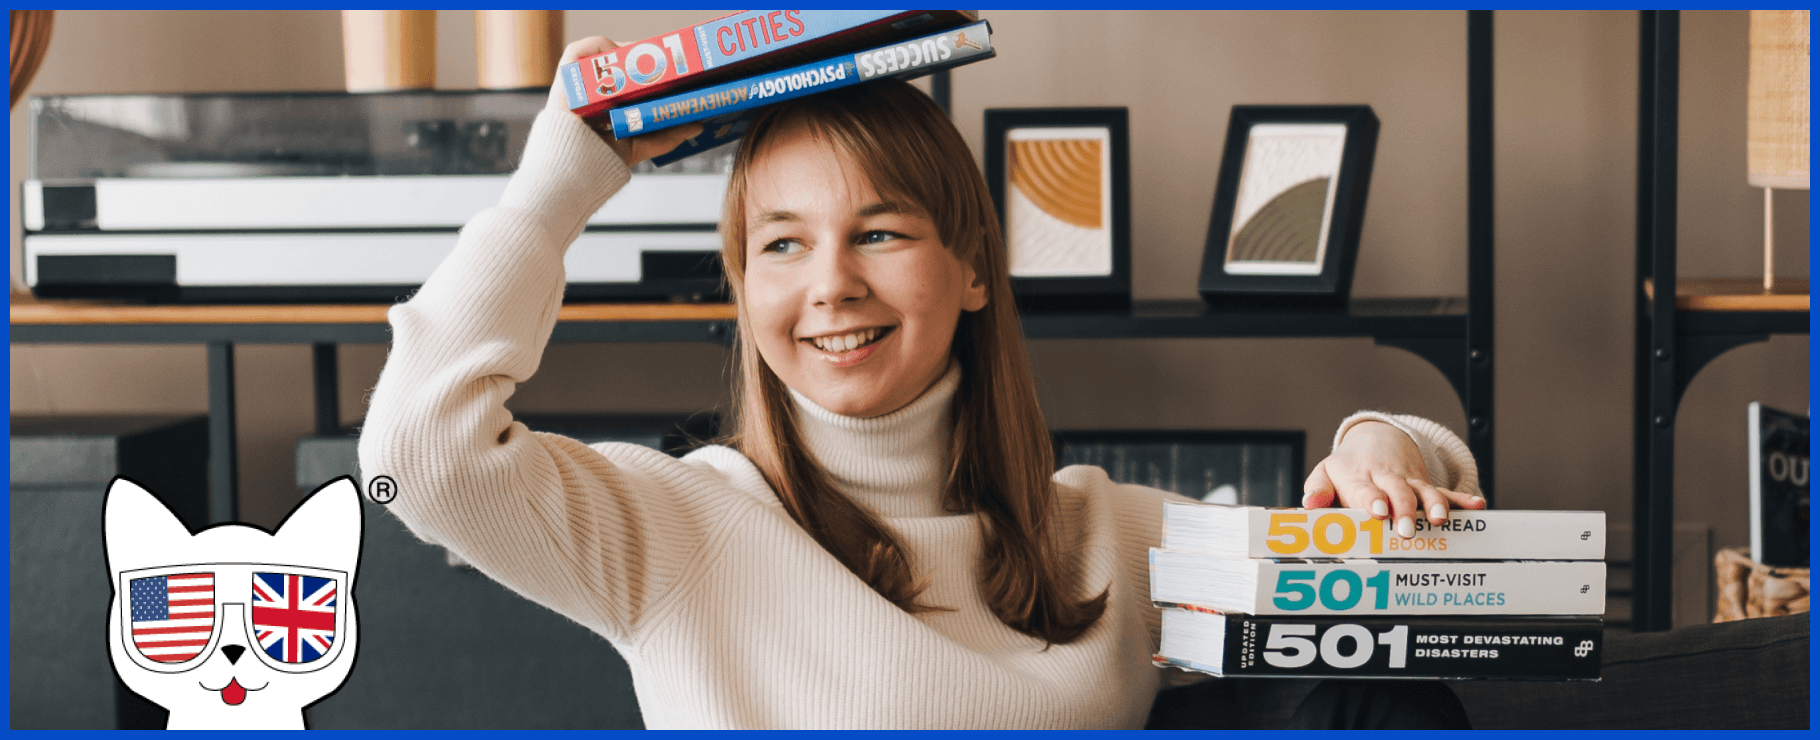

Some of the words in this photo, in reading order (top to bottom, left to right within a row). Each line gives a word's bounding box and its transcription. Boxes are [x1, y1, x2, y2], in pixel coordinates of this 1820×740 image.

[697, 26, 714, 68] MUST-VISIT
[716, 10, 805, 56] CITIES
[591, 33, 689, 96] 501
[859, 36, 951, 77] SUCCESS
[570, 67, 584, 101] UPDATED
[758, 63, 846, 99] PSYCHOLOGY
[627, 109, 643, 131] DK
[653, 87, 748, 122] ACHIEVEMENT
[1265, 513, 1384, 555] 501
[1389, 519, 1486, 532] STREAD
[1389, 537, 1448, 551] BOOKS
[1272, 569, 1390, 611] 501
[1395, 574, 1486, 587] MUST-VISIT
[1395, 593, 1437, 606] WILD
[1443, 593, 1505, 606] PLACES
[1241, 620, 1249, 669] UPDATED
[1248, 623, 1256, 666] EDITION
[1262, 623, 1408, 669] 501
[1415, 635, 1459, 645] MOST
[1463, 635, 1564, 646] DEVASTATING
[1415, 649, 1499, 659] DISASTERS
